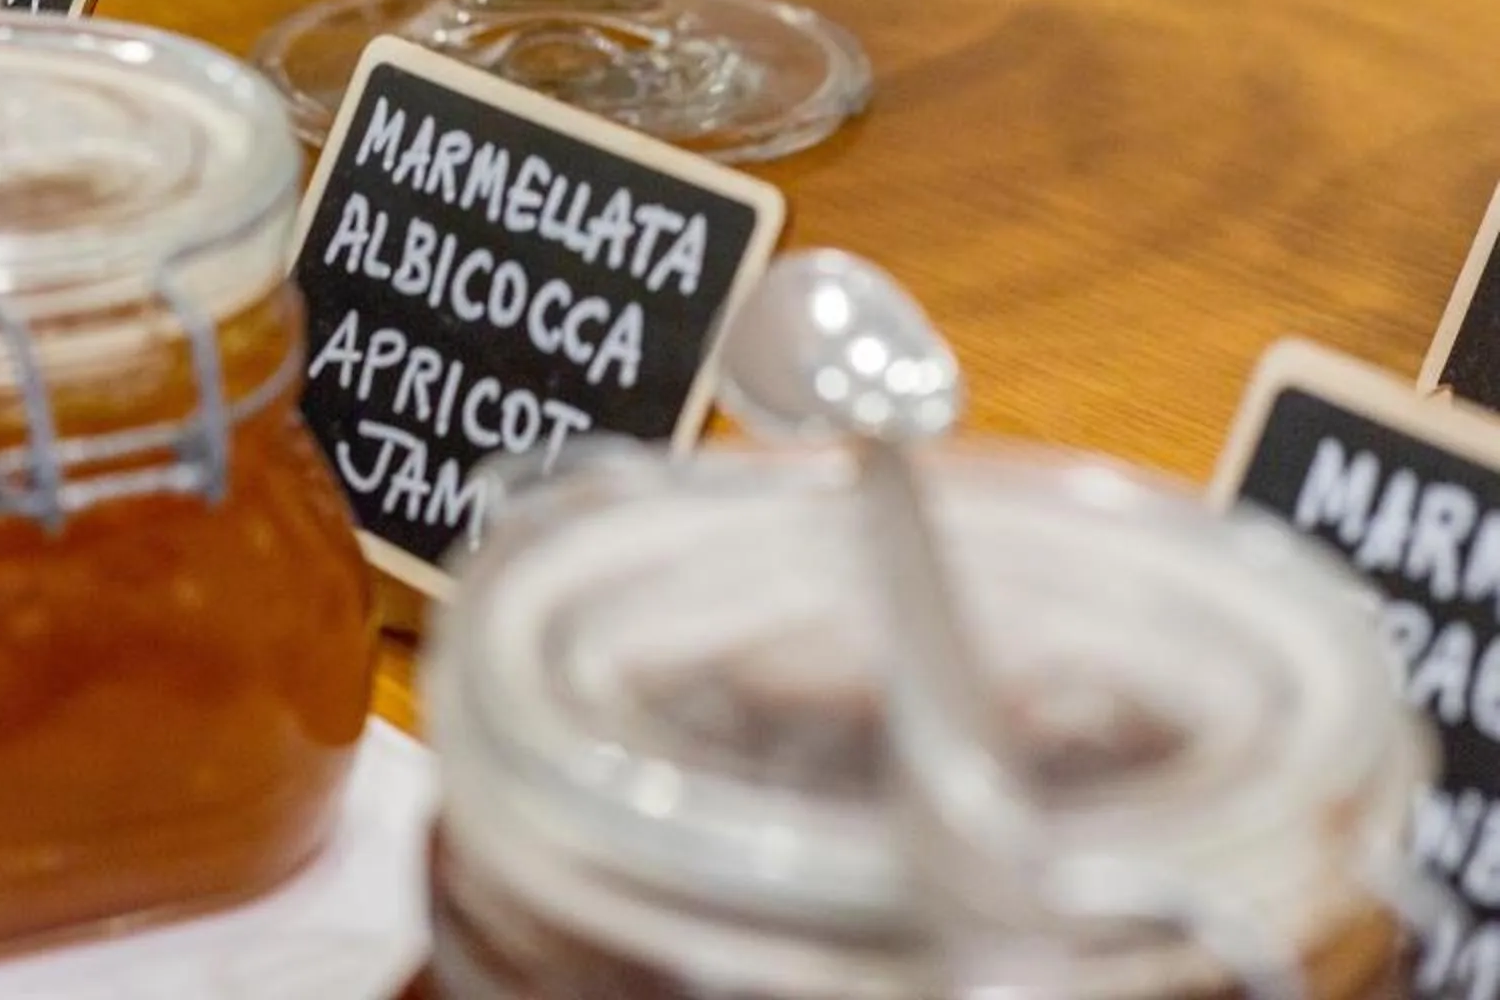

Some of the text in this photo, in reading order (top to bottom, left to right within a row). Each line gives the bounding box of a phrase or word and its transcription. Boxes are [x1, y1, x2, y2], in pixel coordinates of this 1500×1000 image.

[355, 96, 707, 295] MARMELLATA
[325, 193, 643, 388] ALBICOCCA
[309, 310, 590, 475] APRICOT
[336, 419, 487, 552] JAM
